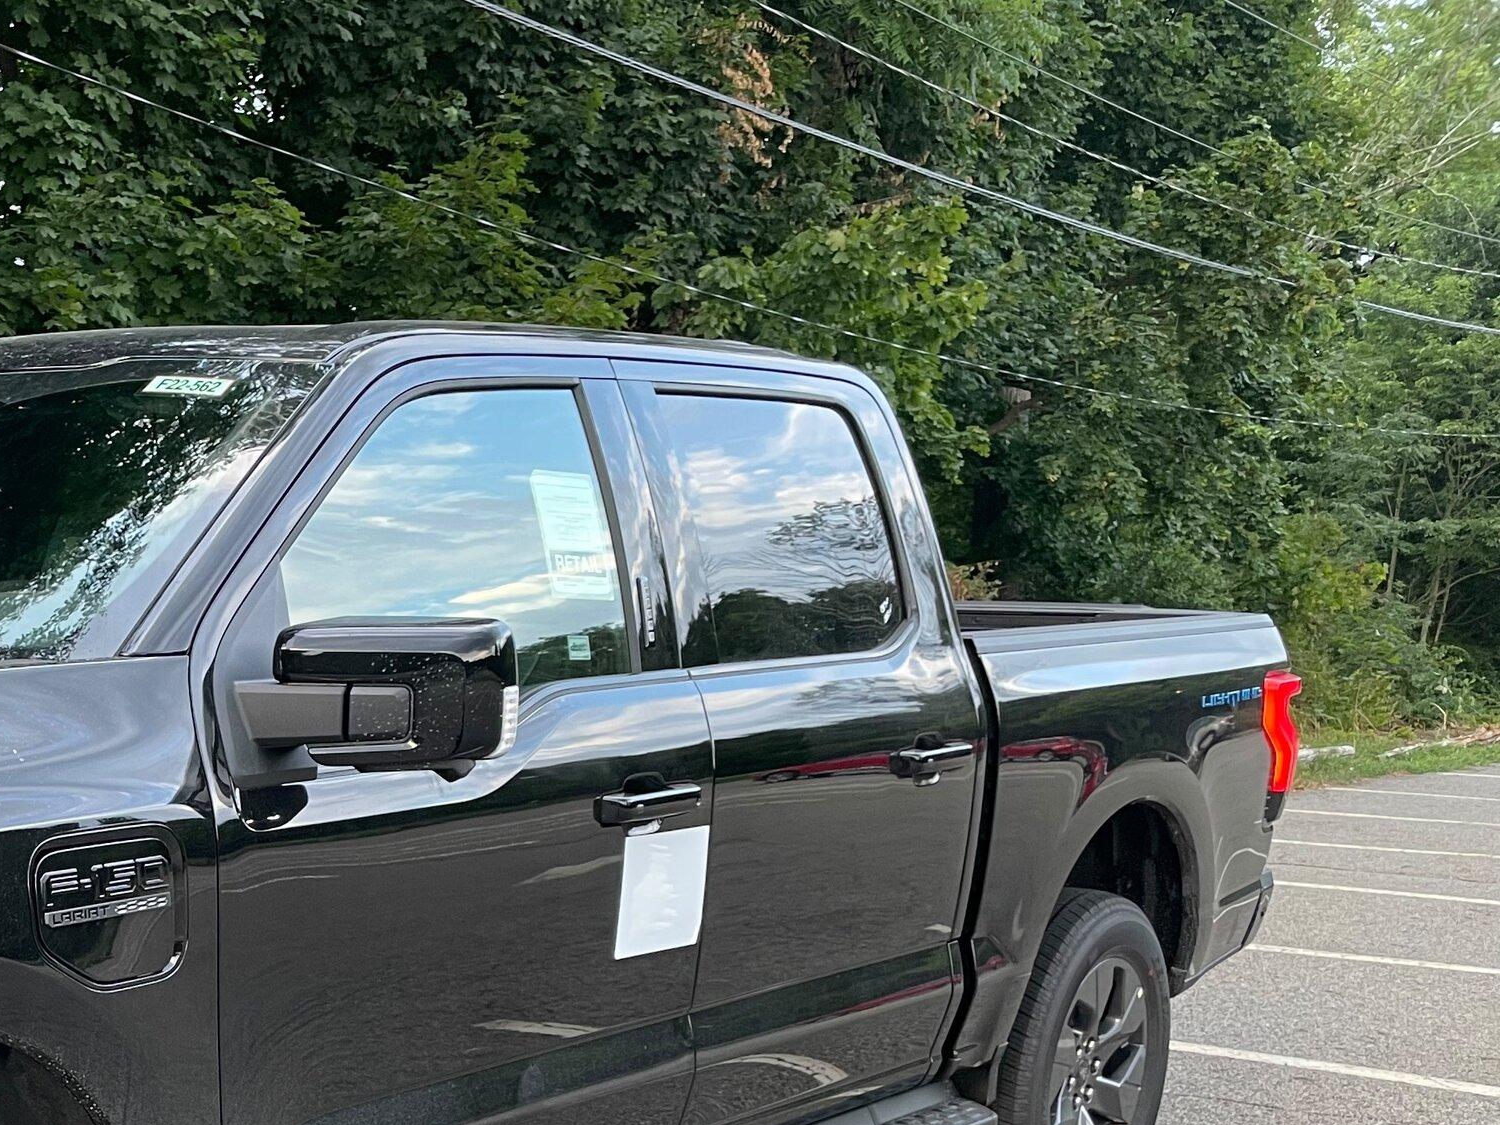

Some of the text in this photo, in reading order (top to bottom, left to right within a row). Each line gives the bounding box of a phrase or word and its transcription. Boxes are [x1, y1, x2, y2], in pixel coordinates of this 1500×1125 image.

[155, 378, 222, 393] F22-562
[39, 854, 169, 907] F-150
[52, 904, 111, 925] LARIAT
